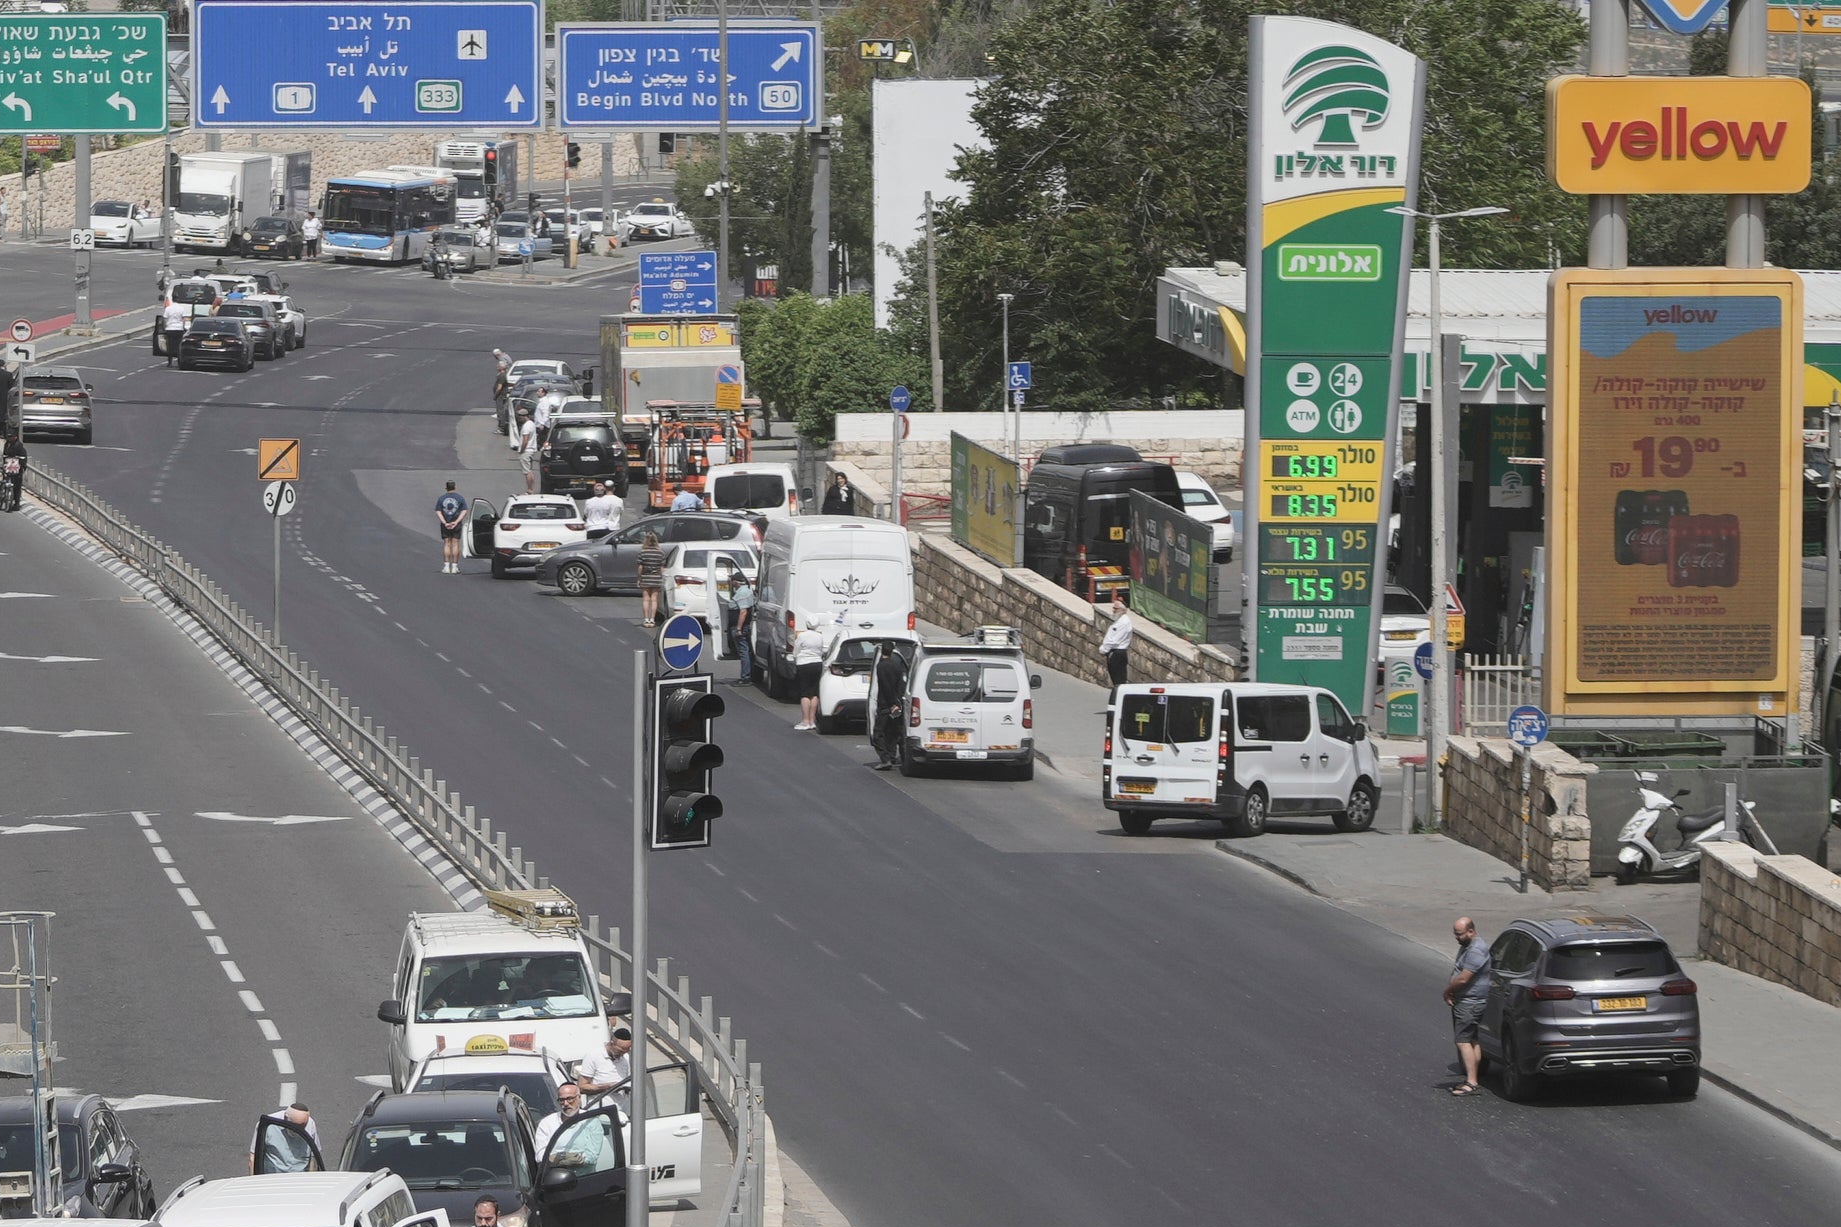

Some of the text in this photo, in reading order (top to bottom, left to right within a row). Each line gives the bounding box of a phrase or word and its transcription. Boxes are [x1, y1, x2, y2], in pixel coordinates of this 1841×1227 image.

[327, 13, 411, 31] תל אביב
[48, 26, 101, 41] גבעת
[122, 48, 148, 65] حي
[337, 36, 399, 59] تل أبيب
[598, 48, 637, 67] צפון
[646, 48, 680, 66] בגין
[52, 70, 112, 84] Sha'ul
[120, 69, 153, 85] Qtr
[327, 62, 409, 77] Tel Aviv
[588, 69, 633, 88] شمال
[291, 92, 299, 105] 1
[423, 90, 455, 103] 333
[577, 92, 748, 110] Begin Blvd Noth
[770, 91, 791, 103] 50
[1582, 107, 1788, 169] yellow
[1274, 151, 1397, 177] דור אלון
[73, 234, 92, 245] 6.2
[1288, 251, 1372, 273] אלונית
[1644, 305, 1718, 326] yellow
[1703, 377, 1766, 392] שישייה
[1614, 396, 1746, 414] קוקה-קולה זירו
[1290, 411, 1316, 421] ATM
[1676, 415, 1701, 426] 400
[1337, 444, 1376, 464] סולר
[1289, 455, 1337, 477] 6.99
[1337, 483, 1375, 503] סולר
[1288, 495, 1337, 517] 8.35
[1285, 537, 1335, 560] 7.31
[1341, 529, 1368, 550] 95
[1285, 577, 1335, 601] 7.55
[1340, 570, 1368, 591] 95
[1268, 608, 1355, 619] תחנה שומרת
[1295, 622, 1328, 634] שבת
[1510, 718, 1545, 733] יציאה
